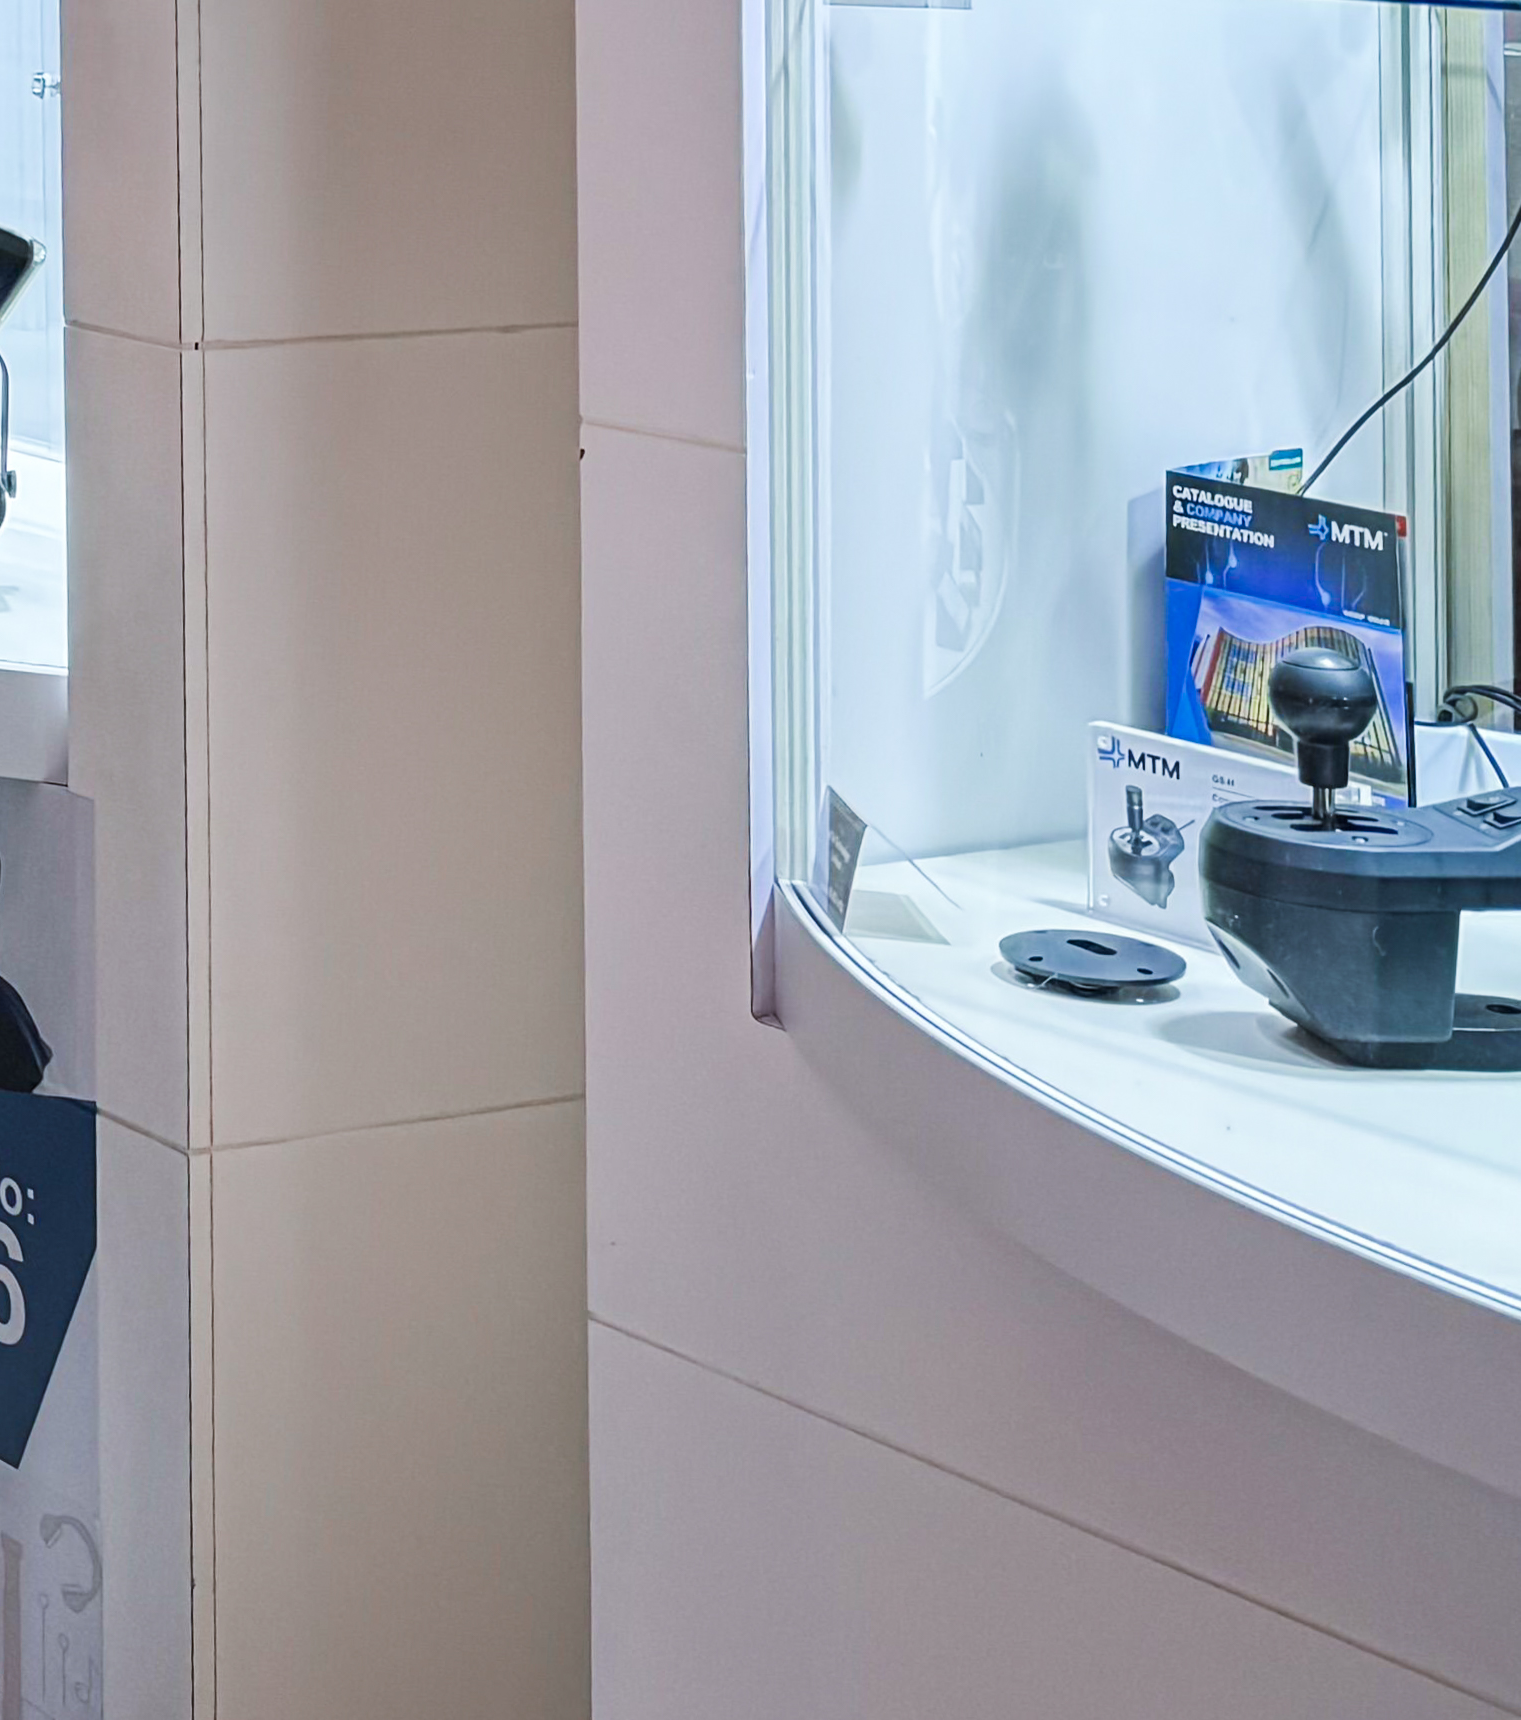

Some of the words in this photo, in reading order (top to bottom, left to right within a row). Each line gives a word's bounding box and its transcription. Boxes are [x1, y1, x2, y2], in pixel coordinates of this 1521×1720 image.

[1172, 485, 1253, 514] CATALOGUE
[1172, 500, 1184, 514] &
[1186, 501, 1253, 527] COMPANY
[1172, 514, 1275, 549] PRESENTATION
[1330, 520, 1384, 551] MTM
[1127, 748, 1181, 780] MTM
